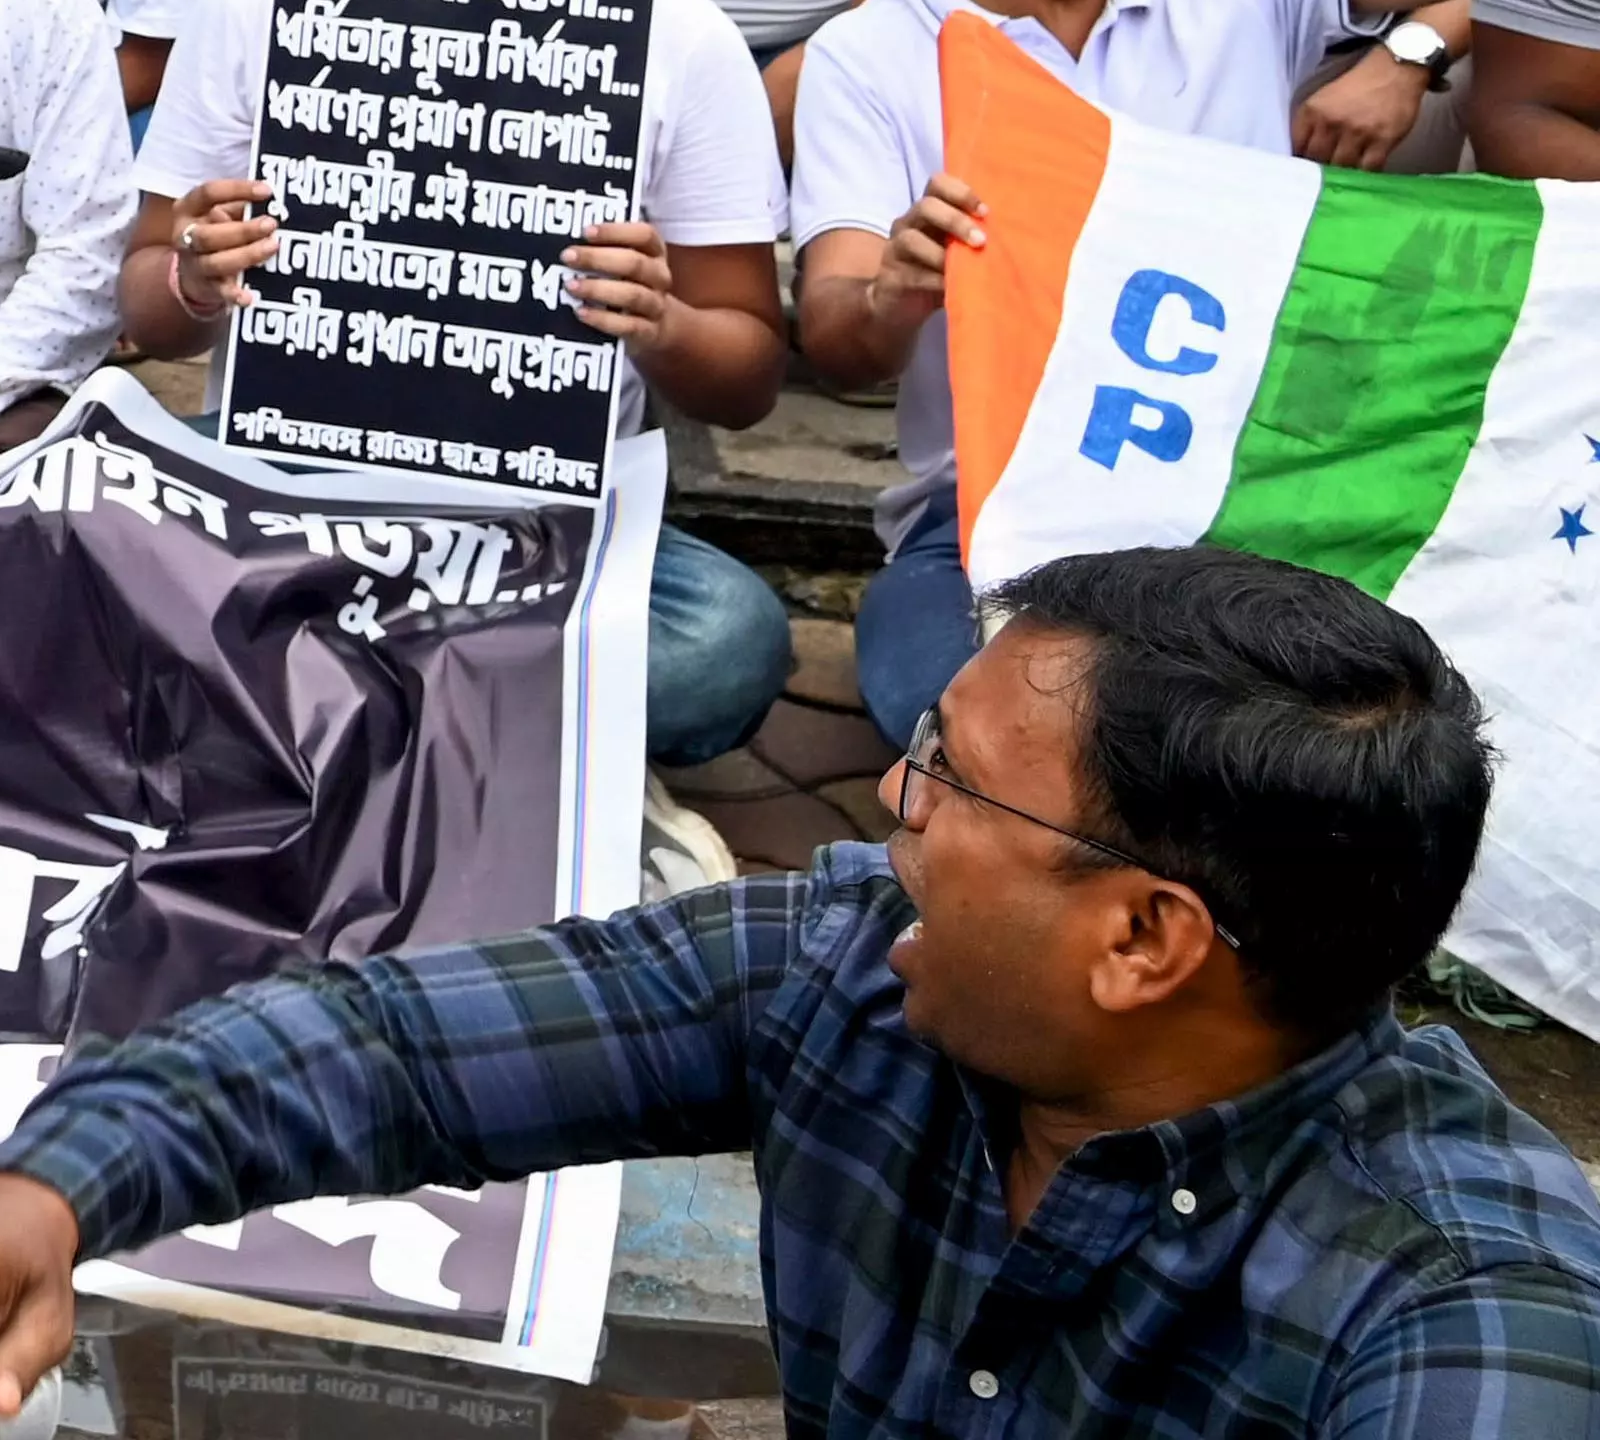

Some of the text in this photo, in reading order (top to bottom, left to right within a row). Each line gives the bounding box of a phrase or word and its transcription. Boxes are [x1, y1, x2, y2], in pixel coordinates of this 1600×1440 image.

[409, 25, 485, 96] মূল্য
[268, 65, 385, 145] ধর্ষণের
[387, 93, 486, 153] প্রমাণ
[260, 149, 416, 224] মুখ্যমন্ত্রীর
[415, 162, 469, 228] এই
[458, 252, 527, 305] মত
[346, 308, 441, 368] প্রধান
[365, 429, 439, 467] রাজ্য
[441, 440, 502, 477] ছাত্র
[504, 445, 599, 491] পরিষদ
